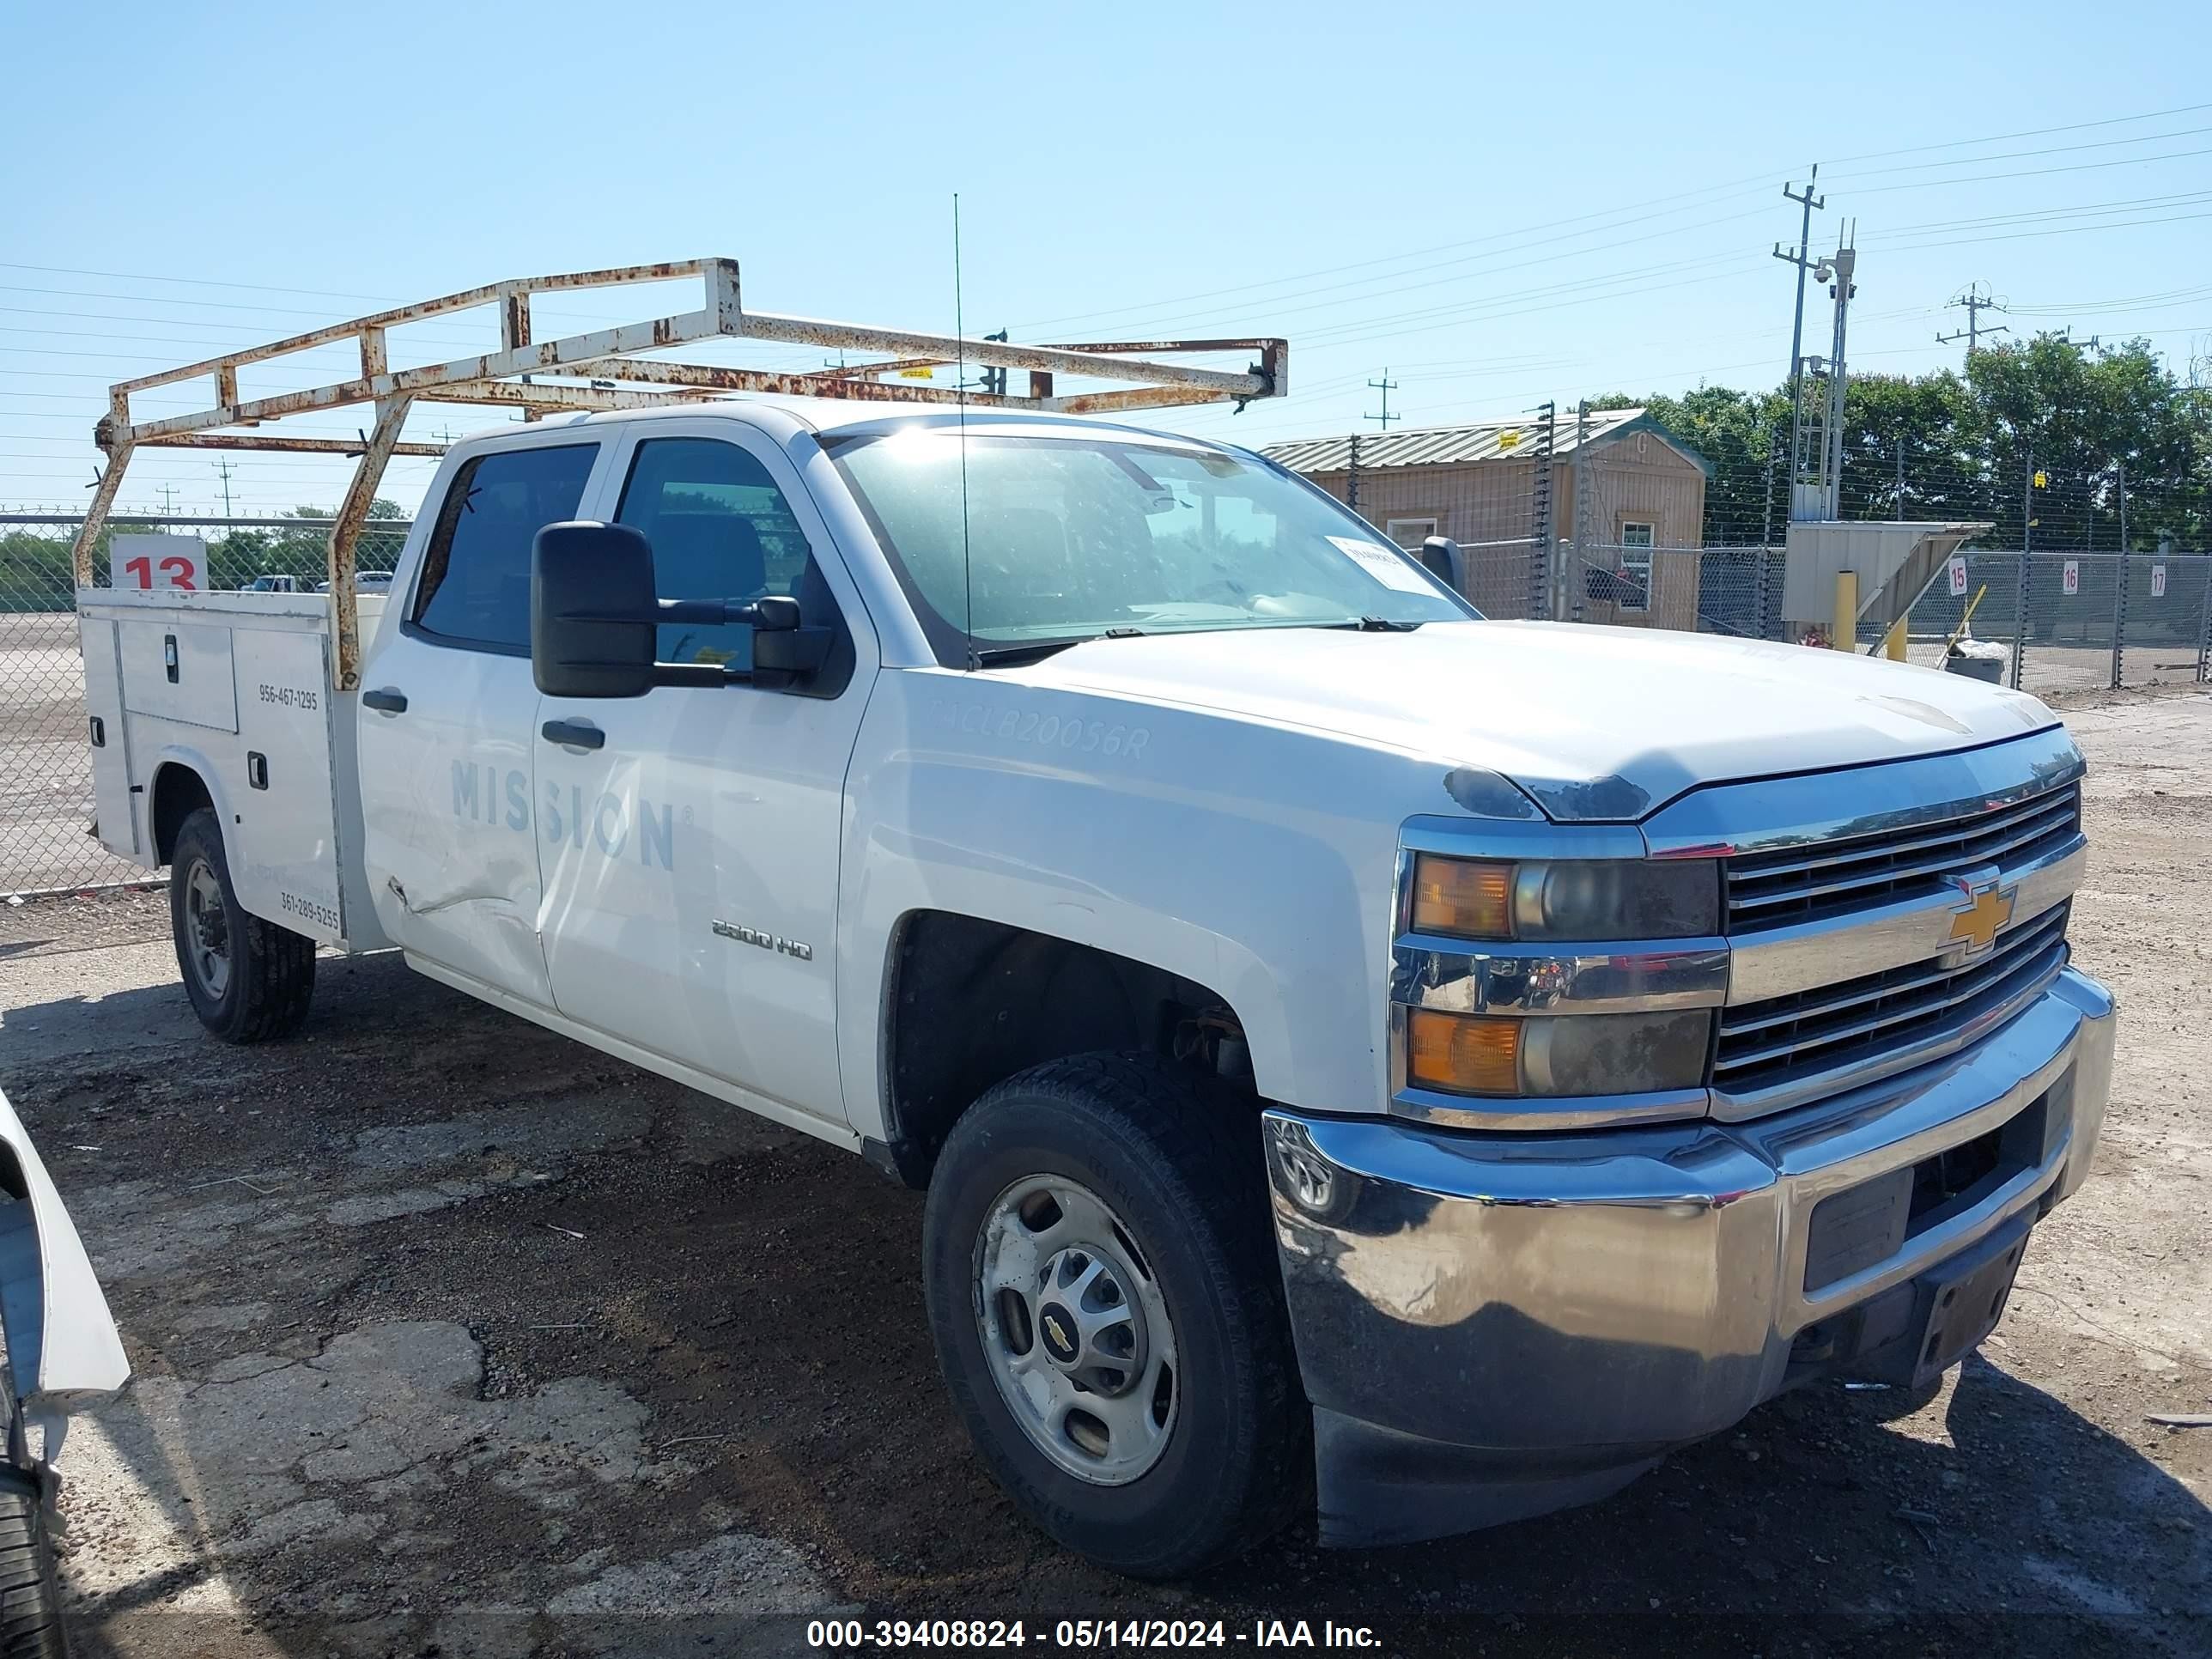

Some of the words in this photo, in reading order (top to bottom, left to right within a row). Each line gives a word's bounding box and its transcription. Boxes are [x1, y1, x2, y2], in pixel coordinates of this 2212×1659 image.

[125, 556, 197, 591] 13
[1951, 567, 1965, 589] 15
[2065, 568, 2076, 588] 16
[2154, 573, 2164, 592] 17
[259, 684, 318, 711] 956-467-1295
[281, 891, 338, 931] 361-289-5255
[712, 918, 773, 950] 2500
[777, 936, 812, 961] HD
